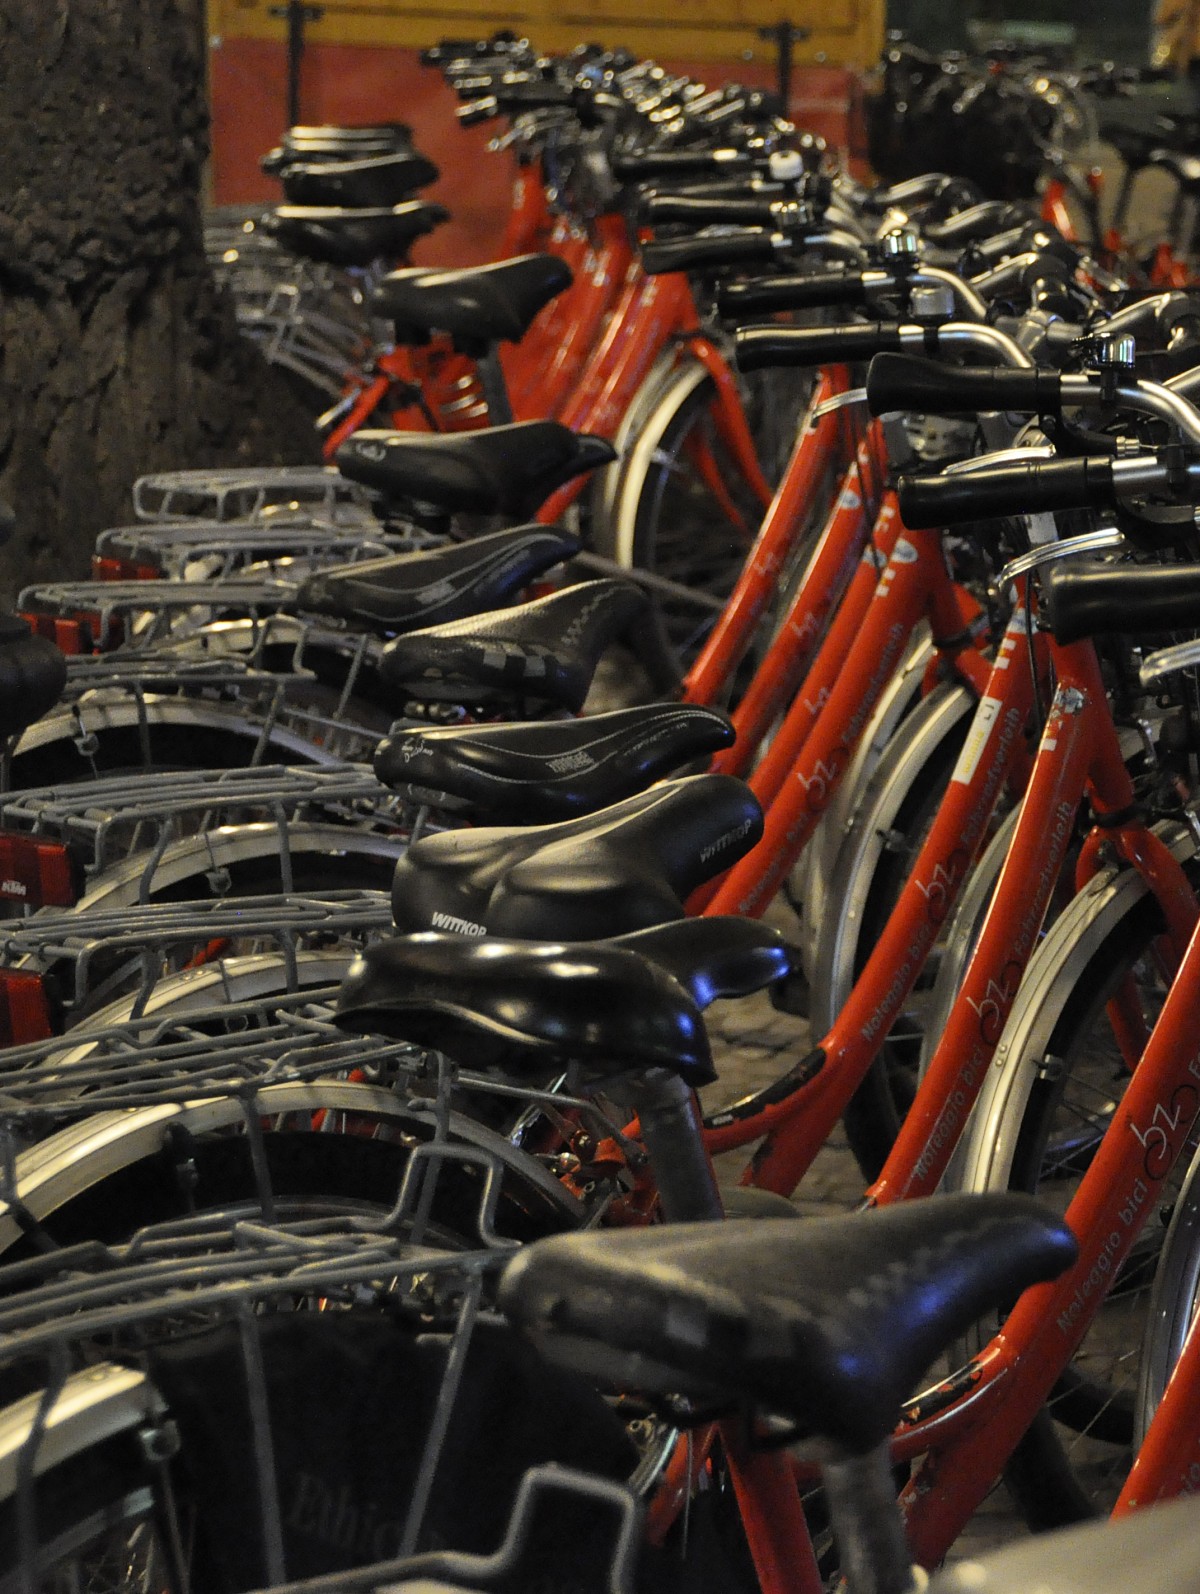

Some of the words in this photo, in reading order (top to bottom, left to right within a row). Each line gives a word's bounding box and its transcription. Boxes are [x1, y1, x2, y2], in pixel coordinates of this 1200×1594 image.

[431, 911, 488, 937] WITTKOP
[1130, 1102, 1181, 1160] bz
[1118, 1177, 1149, 1227] bici
[1055, 1230, 1122, 1335] Noleggio
